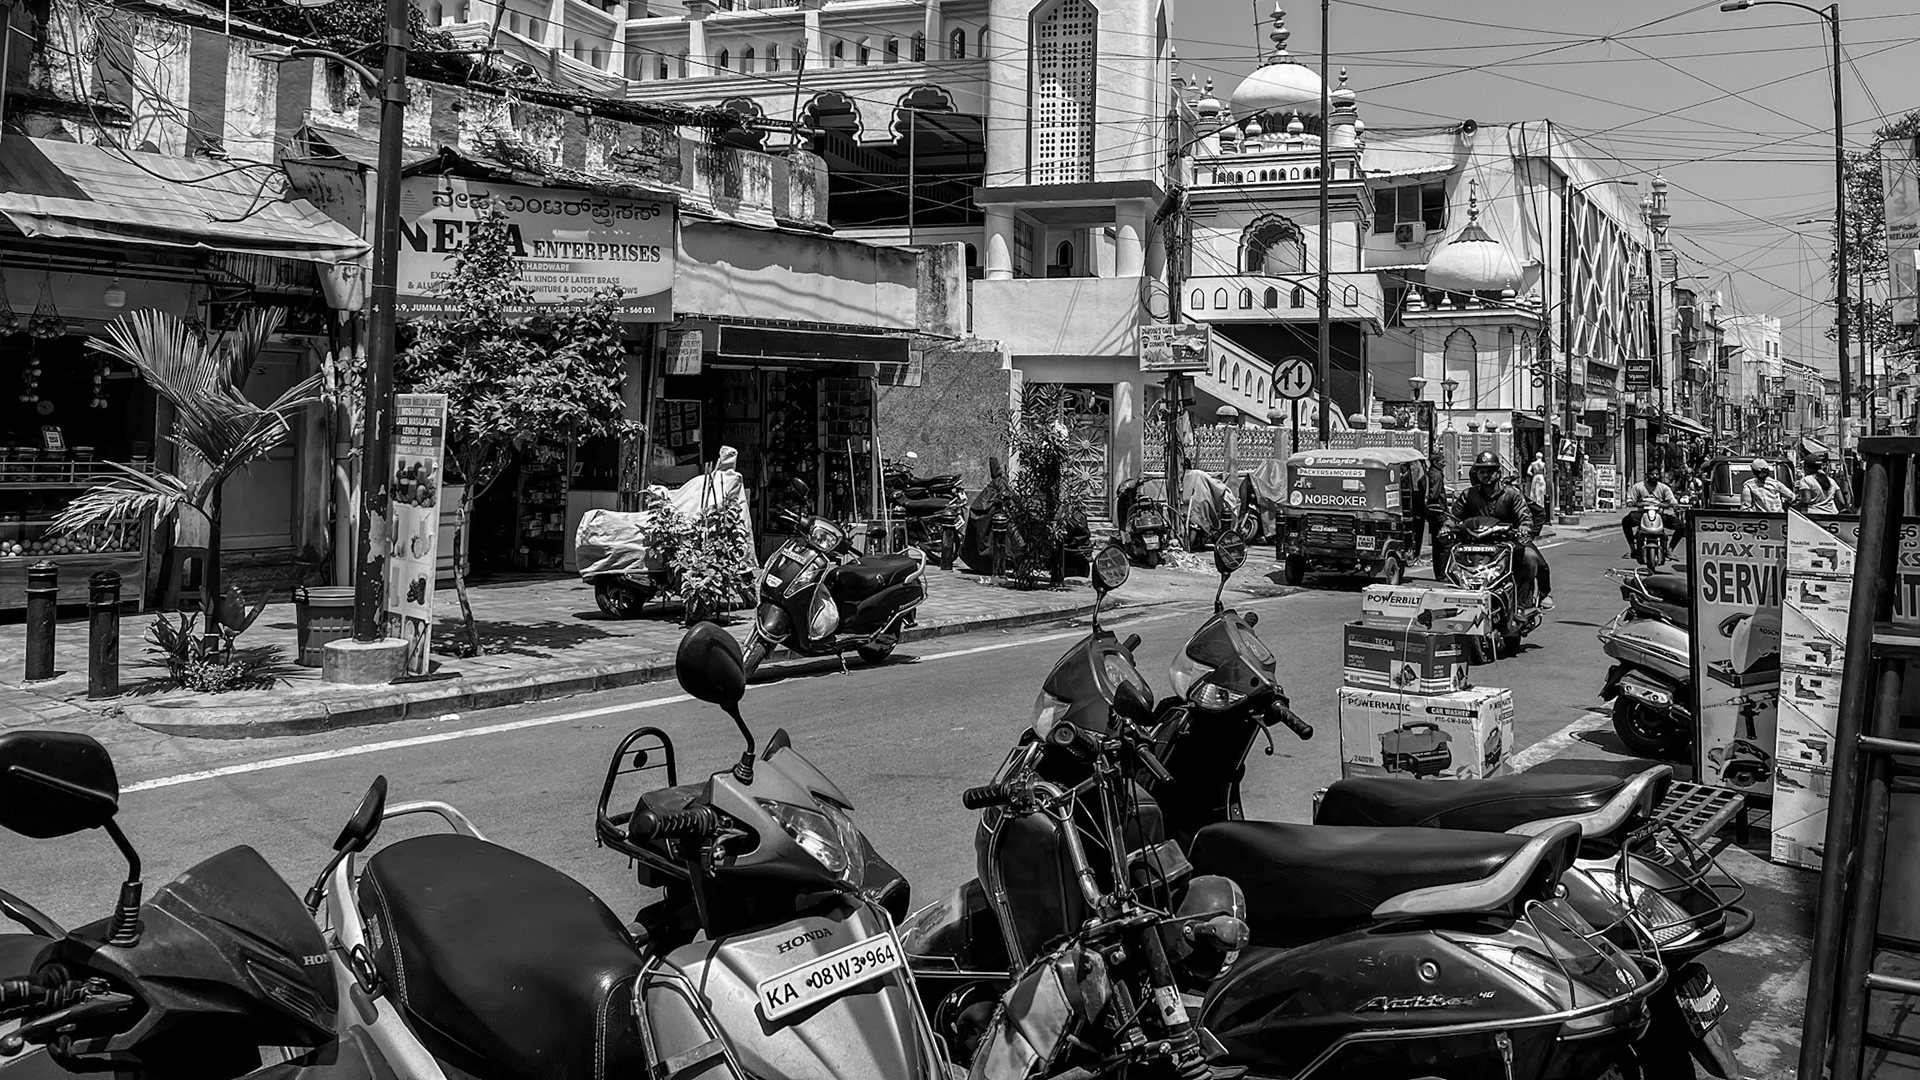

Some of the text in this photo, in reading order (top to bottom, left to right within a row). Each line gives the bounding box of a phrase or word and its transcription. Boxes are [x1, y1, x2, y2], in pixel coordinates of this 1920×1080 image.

[533, 240, 661, 263] ENTERPRISES
[526, 263, 570, 272] HARDWARE
[534, 276, 558, 284] KINDS
[559, 276, 569, 284] OF
[571, 276, 595, 284] LATEST
[597, 277, 620, 285] BRASS
[411, 303, 442, 312] JUMMA
[503, 305, 523, 313] NEAR
[630, 306, 643, 314] 560
[643, 306, 656, 314] 051
[423, 408, 436, 417] JUICE
[396, 416, 408, 425] LASSI
[427, 417, 441, 427] JUICE
[402, 426, 432, 437] LEMON JUICE
[400, 435, 433, 446] GRAPES JUICE
[1304, 494, 1367, 507] NOBROKER
[1702, 542, 1787, 559] MAX TR
[1702, 561, 1787, 607] SERVI
[1367, 591, 1420, 605] POWERBILT
[1759, 627, 1780, 637] BOSCH
[1347, 697, 1412, 712] POWERMATIC
[1431, 707, 1471, 717] CAR WASHER
[1353, 754, 1375, 764] 2400W
[776, 928, 833, 955] HONDA
[766, 982, 800, 1010] KA
